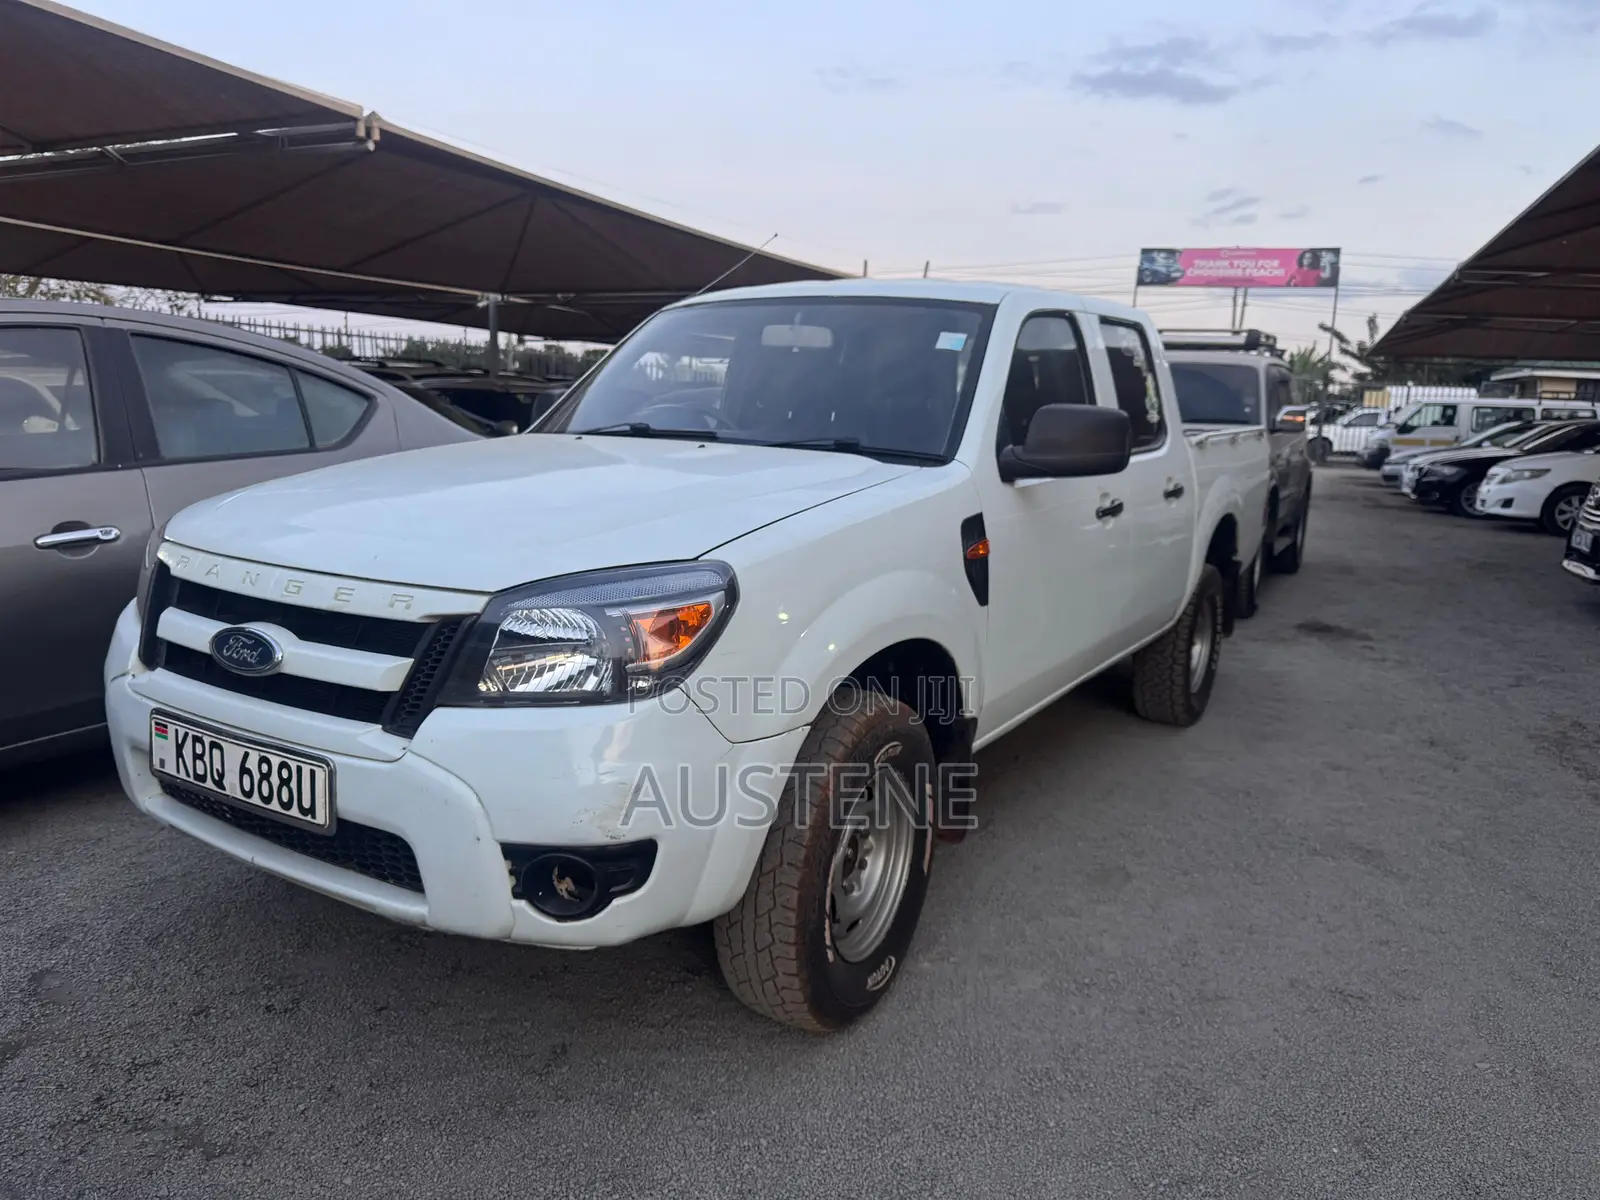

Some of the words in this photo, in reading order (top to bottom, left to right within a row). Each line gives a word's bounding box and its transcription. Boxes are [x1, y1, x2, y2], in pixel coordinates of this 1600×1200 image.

[1193, 259, 1230, 268] THANK
[1232, 259, 1256, 268] YOU
[1257, 259, 1280, 268] FOR
[175, 554, 415, 611] RANGER
[223, 635, 262, 663] Ford
[175, 728, 226, 791] KBQ
[238, 751, 316, 819] 688U
